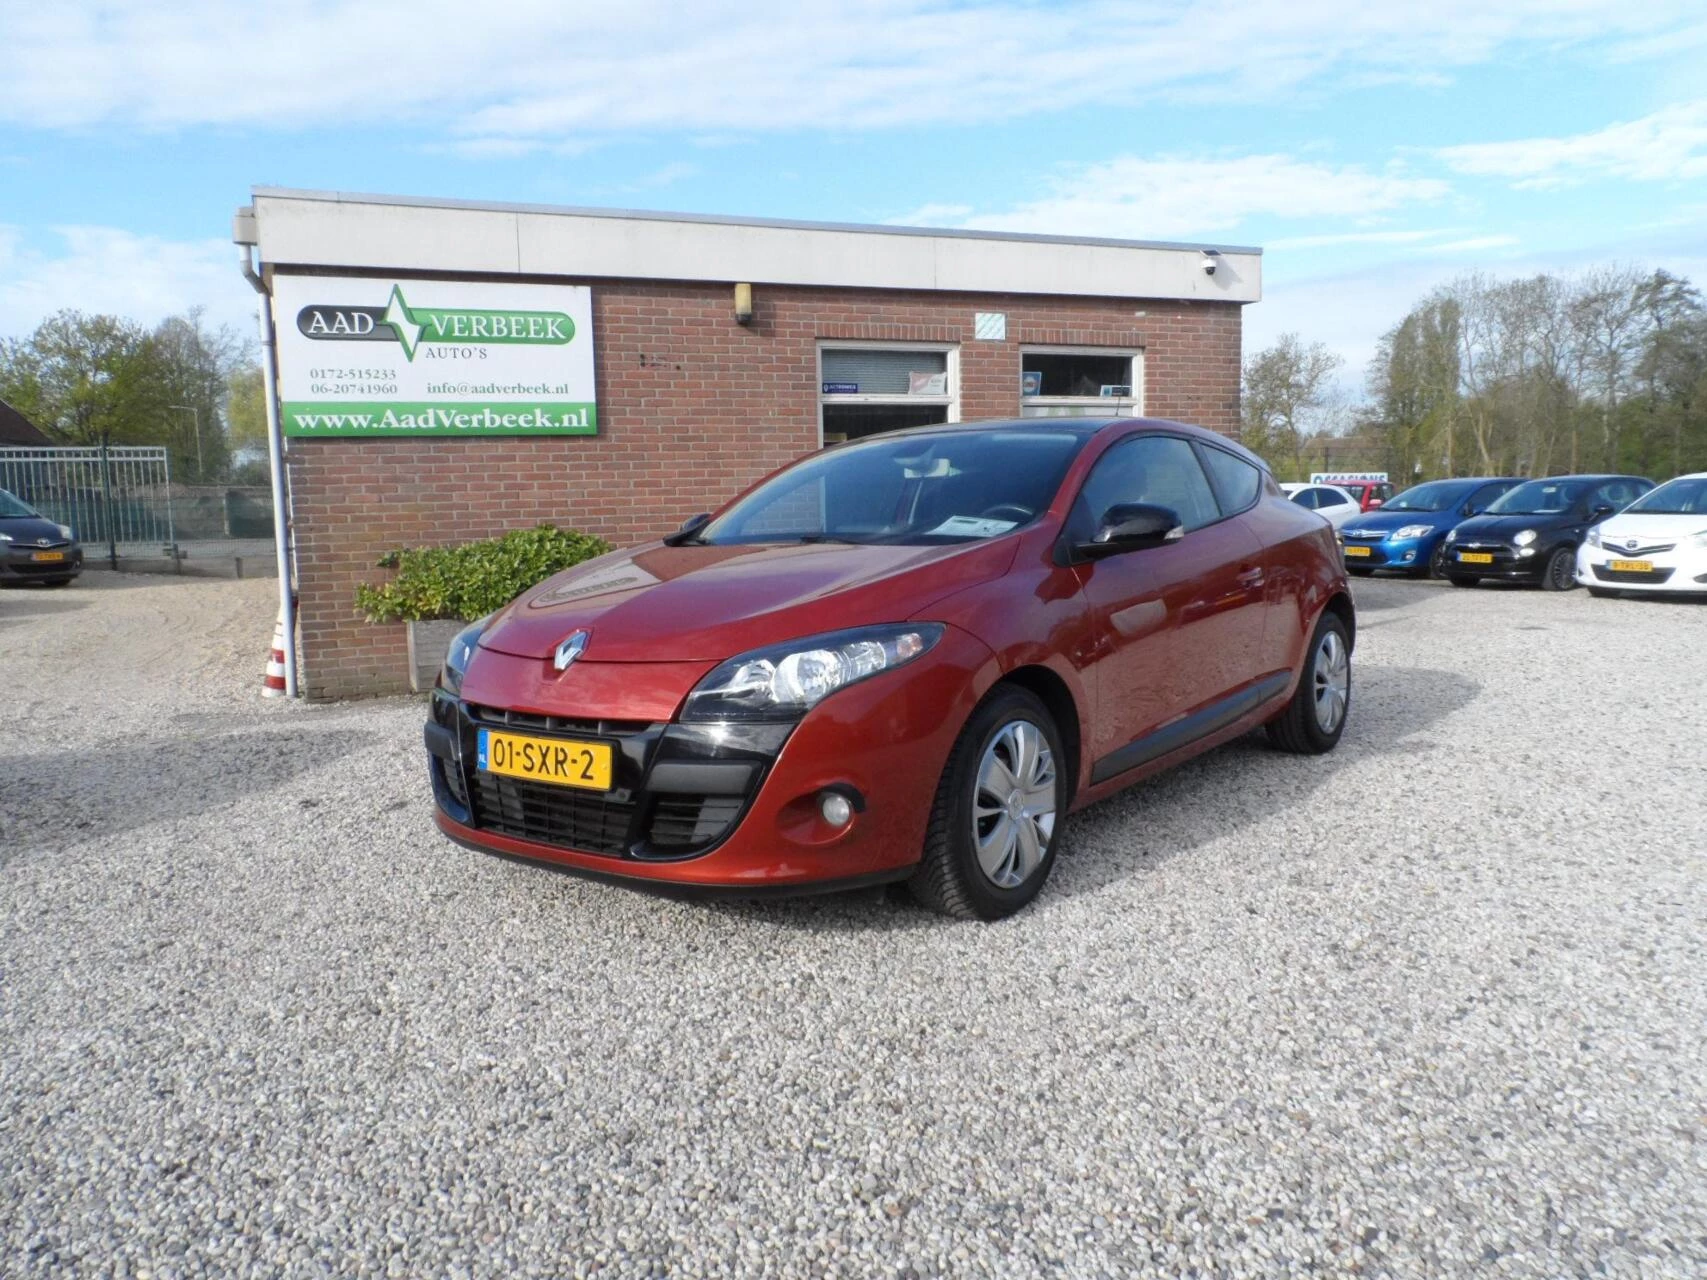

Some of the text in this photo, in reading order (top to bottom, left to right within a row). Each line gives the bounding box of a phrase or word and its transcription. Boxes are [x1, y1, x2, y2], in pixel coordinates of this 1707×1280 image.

[308, 311, 567, 339] AAD VERBEEK
[426, 347, 488, 359] AUTO'S
[311, 383, 398, 394] 06-20741960
[427, 382, 569, 396] info@aadverbeek.nl
[292, 408, 589, 430] www.AadVerbeek.nl
[493, 738, 594, 781] 01-SXR-2
